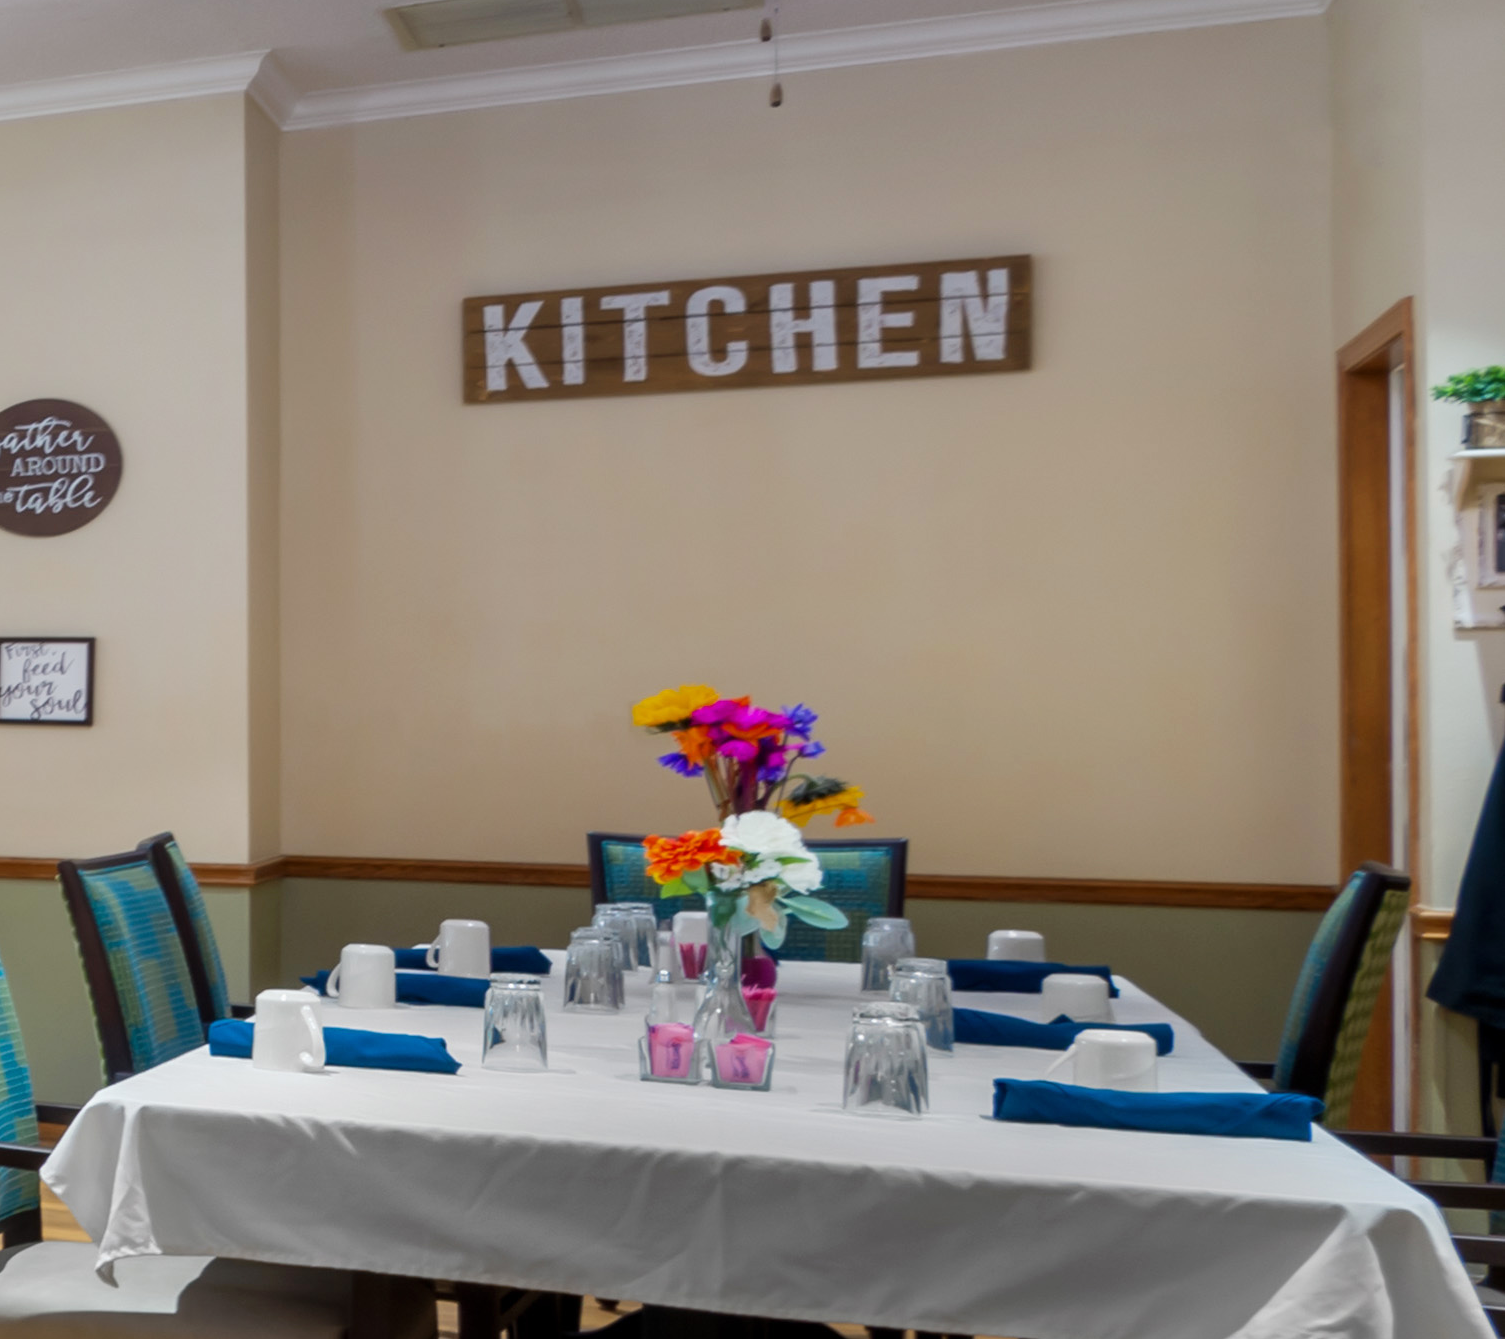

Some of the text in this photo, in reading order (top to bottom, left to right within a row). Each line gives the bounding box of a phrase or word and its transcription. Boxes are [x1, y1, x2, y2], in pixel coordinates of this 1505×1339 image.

[482, 267, 1010, 392] KITCHEN
[10, 452, 106, 477] AROUND
[5, 474, 102, 514] table
[22, 651, 75, 683] feed
[30, 689, 87, 720] soul
